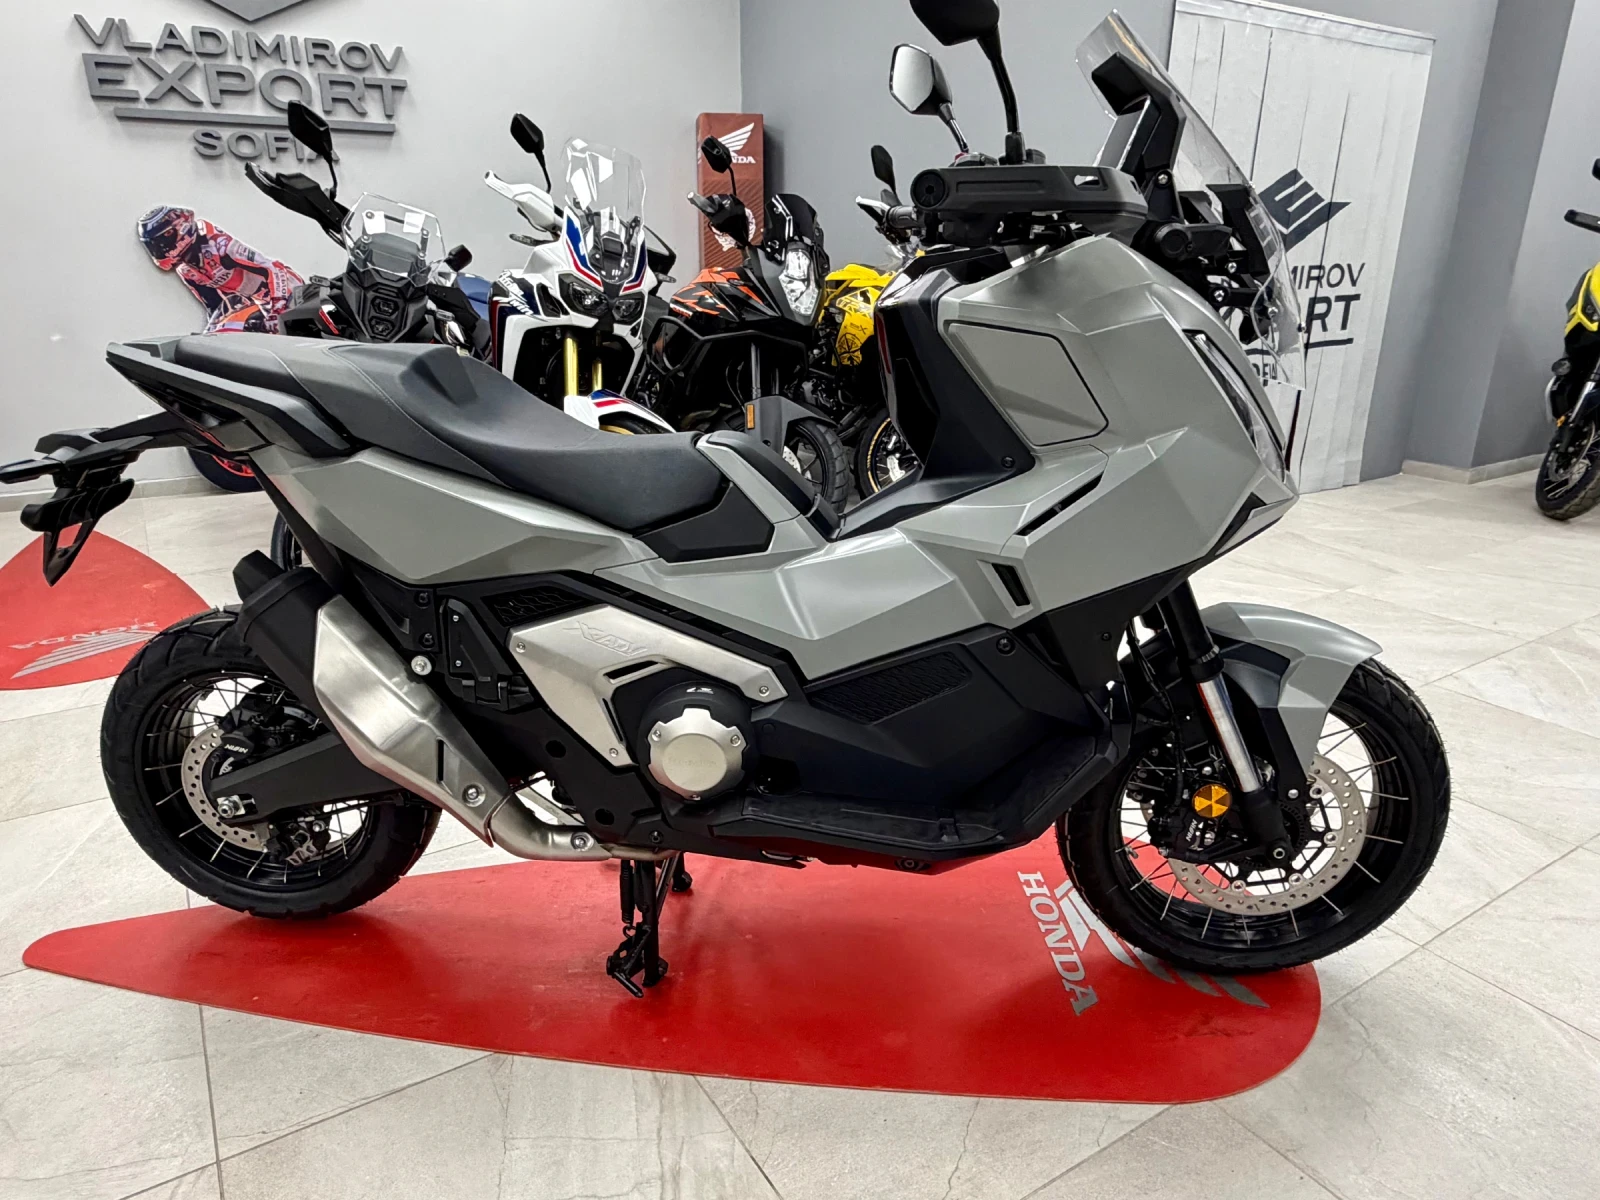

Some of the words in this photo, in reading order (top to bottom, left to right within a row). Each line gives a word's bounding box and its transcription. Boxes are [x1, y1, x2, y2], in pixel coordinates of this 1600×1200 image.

[73, 13, 403, 71] VLADIMIROV
[82, 53, 407, 117] EXPORT
[731, 155, 756, 164] NDA
[1017, 871, 1099, 1016] HONDA
